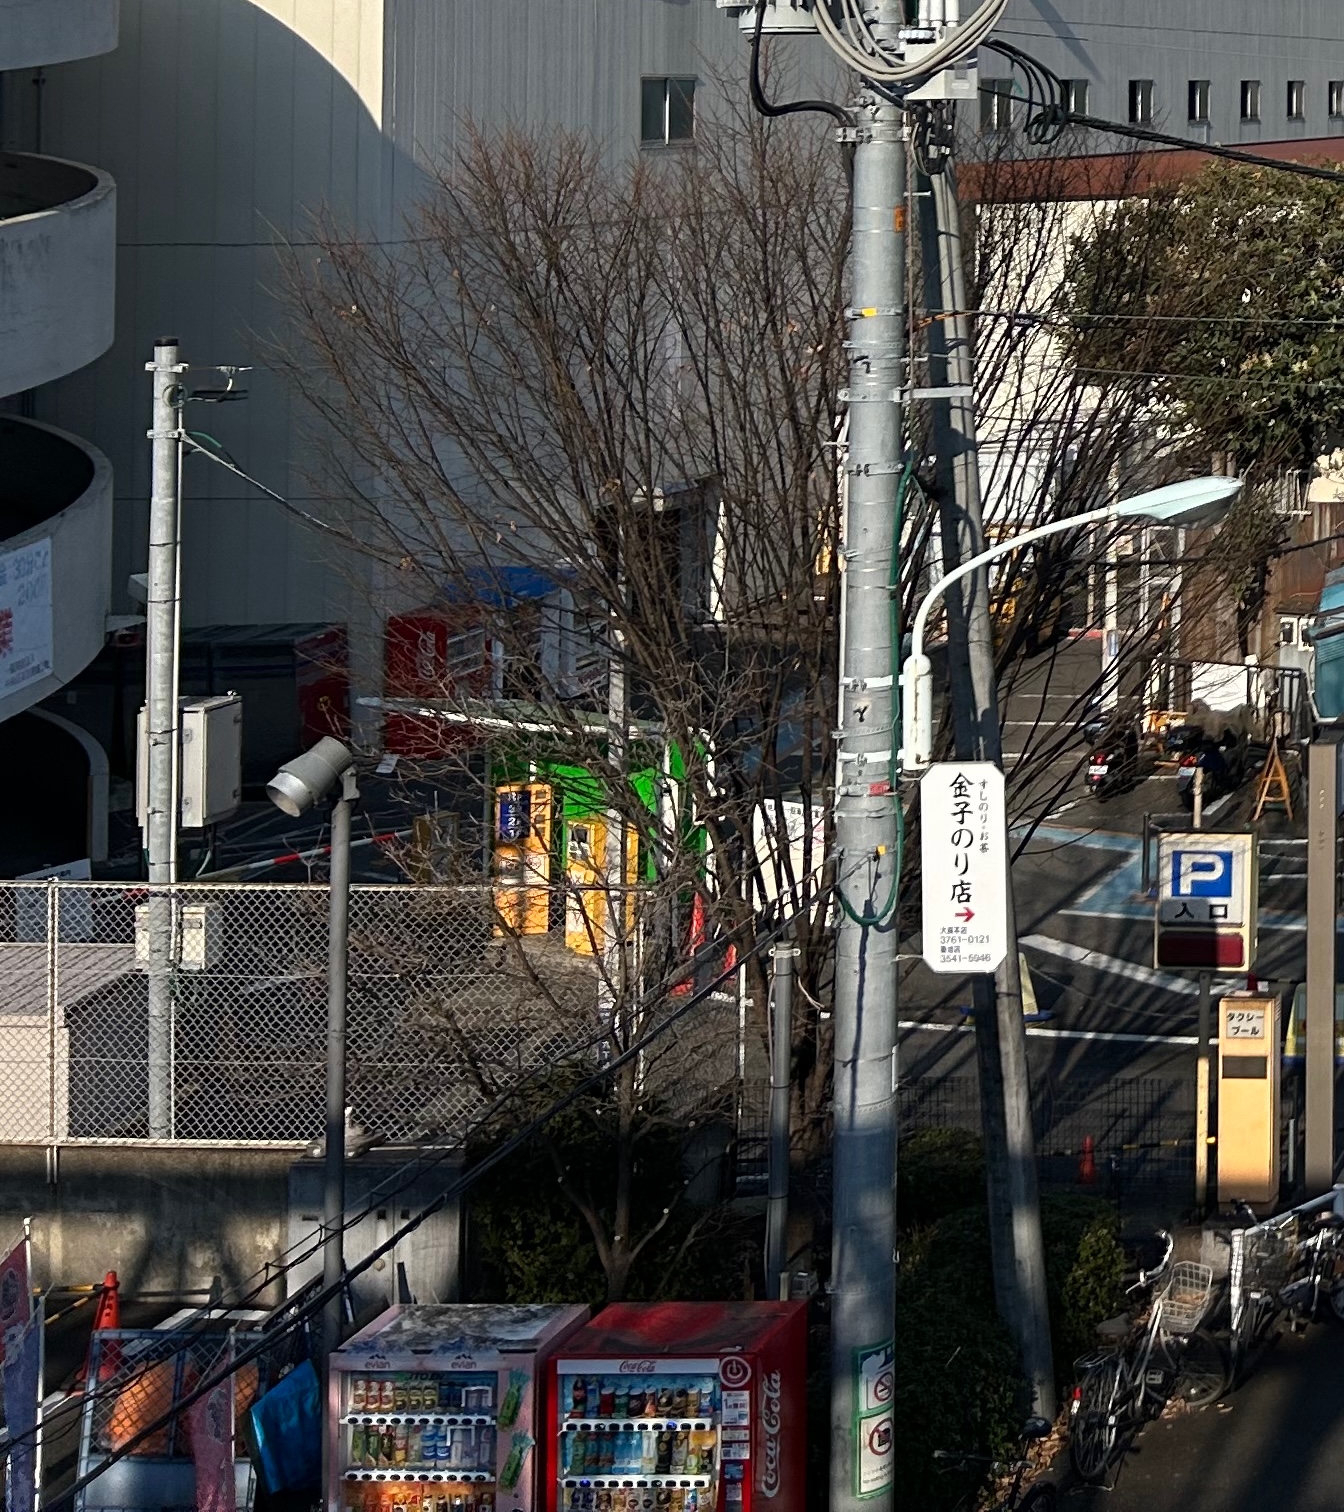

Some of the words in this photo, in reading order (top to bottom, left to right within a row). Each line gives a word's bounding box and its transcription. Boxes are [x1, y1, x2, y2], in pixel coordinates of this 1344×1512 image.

[948, 771, 975, 905] 金子のり店
[1179, 853, 1225, 896] P
[1174, 901, 1229, 919] 入口
[940, 935, 990, 944] 3761-0121
[1226, 1011, 1265, 1022] タクシー
[365, 1360, 391, 1370] evian
[451, 1360, 477, 1370] evian
[761, 1368, 783, 1498] Coca-Cola
